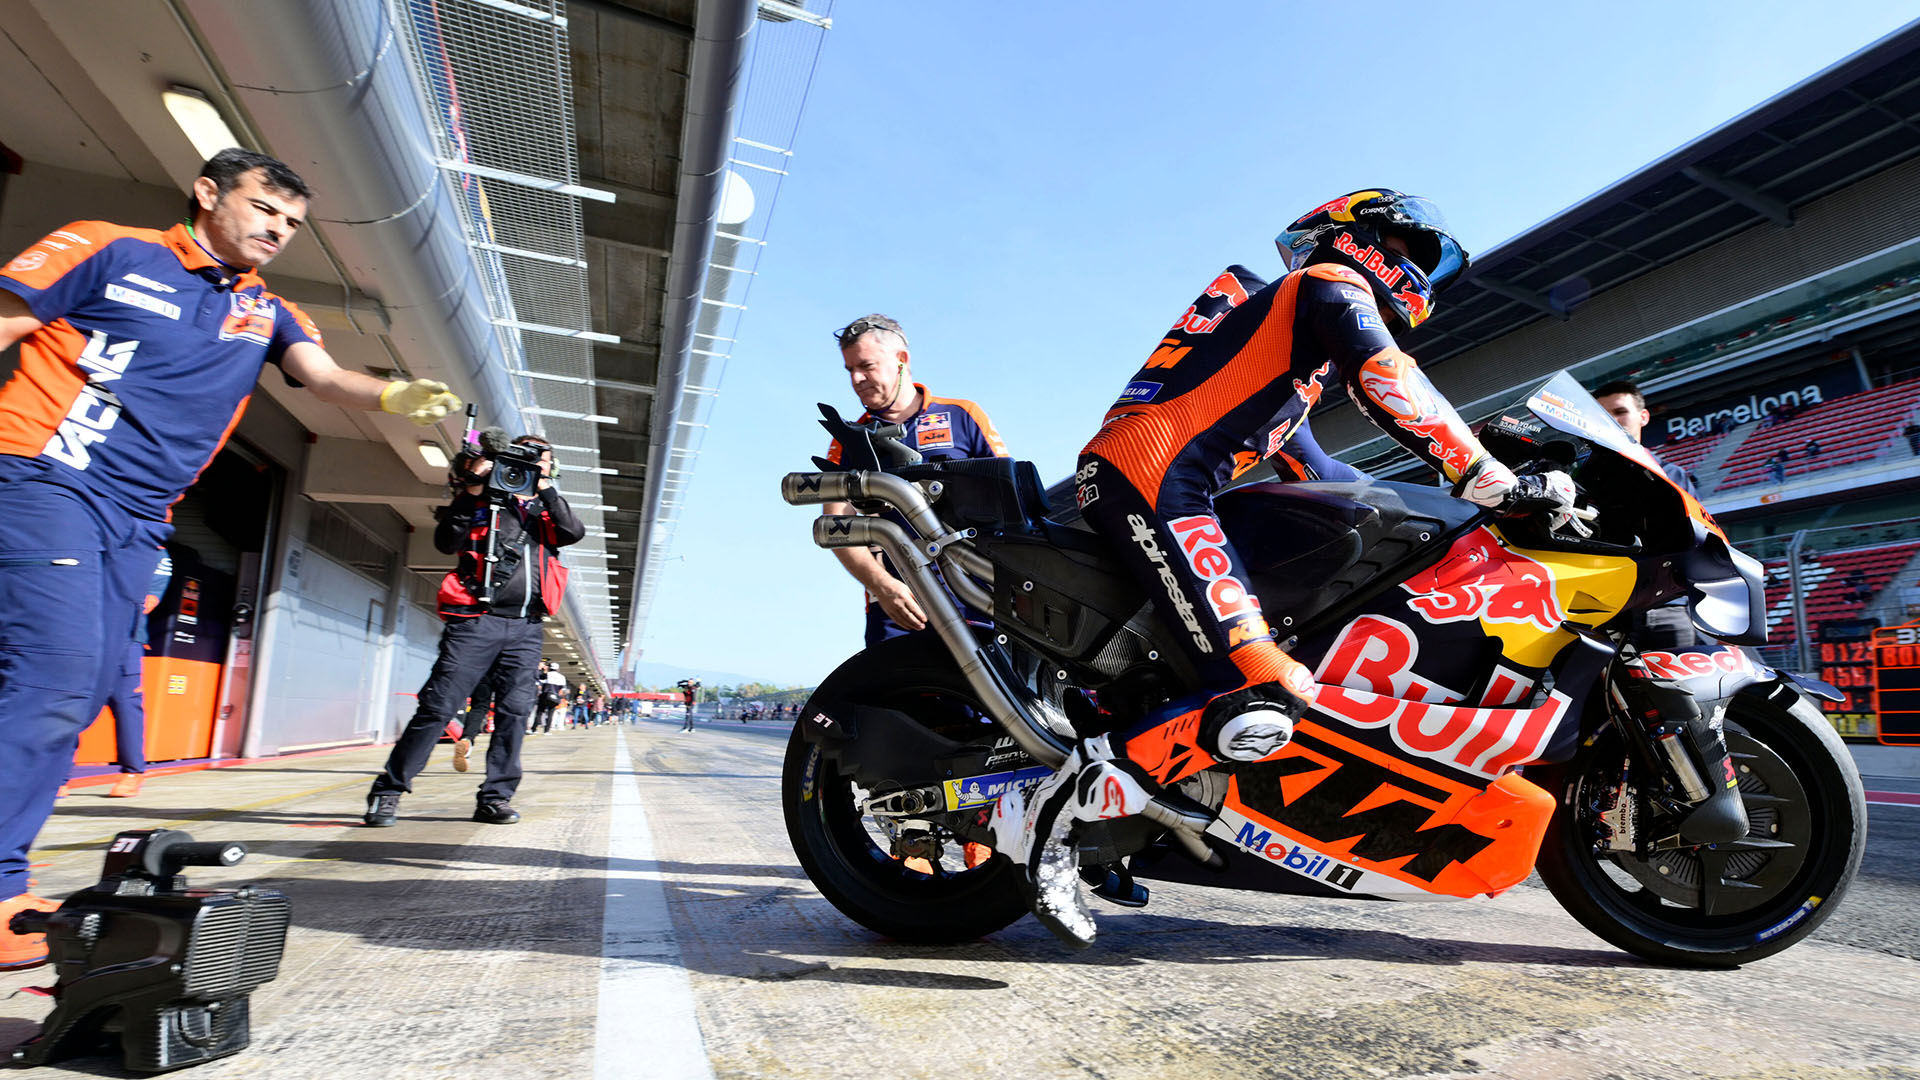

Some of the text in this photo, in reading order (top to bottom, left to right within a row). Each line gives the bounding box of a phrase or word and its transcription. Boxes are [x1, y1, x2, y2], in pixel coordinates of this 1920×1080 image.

[1333, 231, 1405, 290] Red Bull
[1667, 384, 1824, 441] Barcelona
[1126, 513, 1214, 654] alpinestars
[1167, 514, 1264, 623] Red
[1638, 644, 1747, 681] Red
[1309, 613, 1573, 782] Bull
[1228, 729, 1496, 884] KTM
[1618, 802, 1628, 835] brembo
[1234, 821, 1354, 885] Mobil 1
